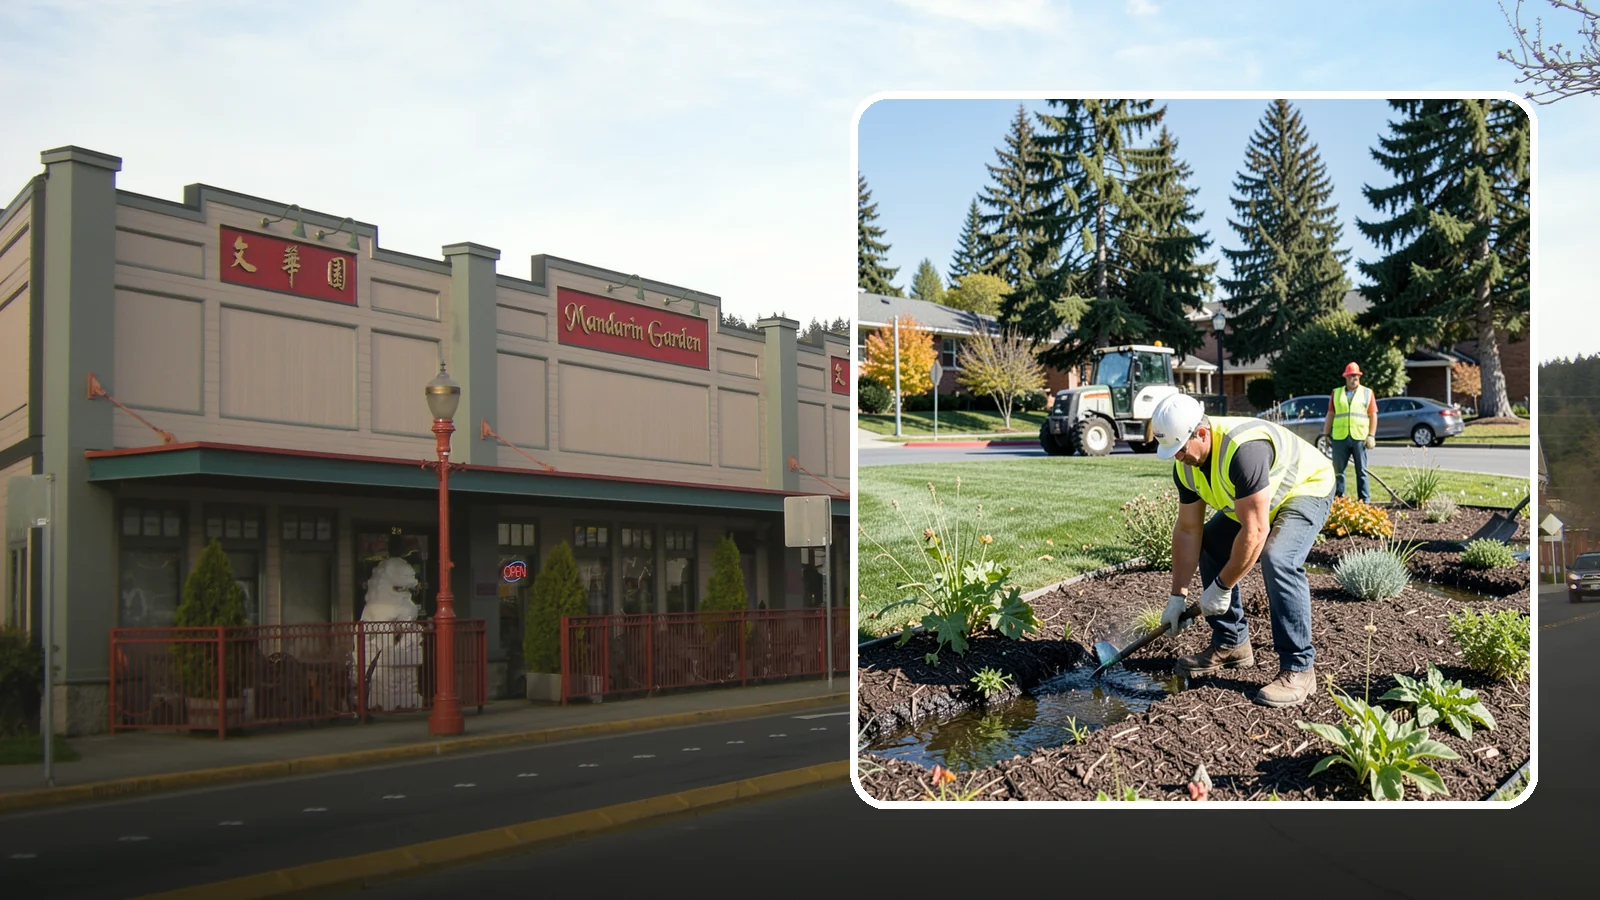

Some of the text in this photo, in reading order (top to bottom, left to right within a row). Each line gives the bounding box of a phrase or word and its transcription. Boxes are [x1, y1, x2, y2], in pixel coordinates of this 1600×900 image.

[231, 236, 346, 291] 文華園
[565, 302, 702, 352] Mandarin Garden
[503, 565, 527, 578] OPEN
